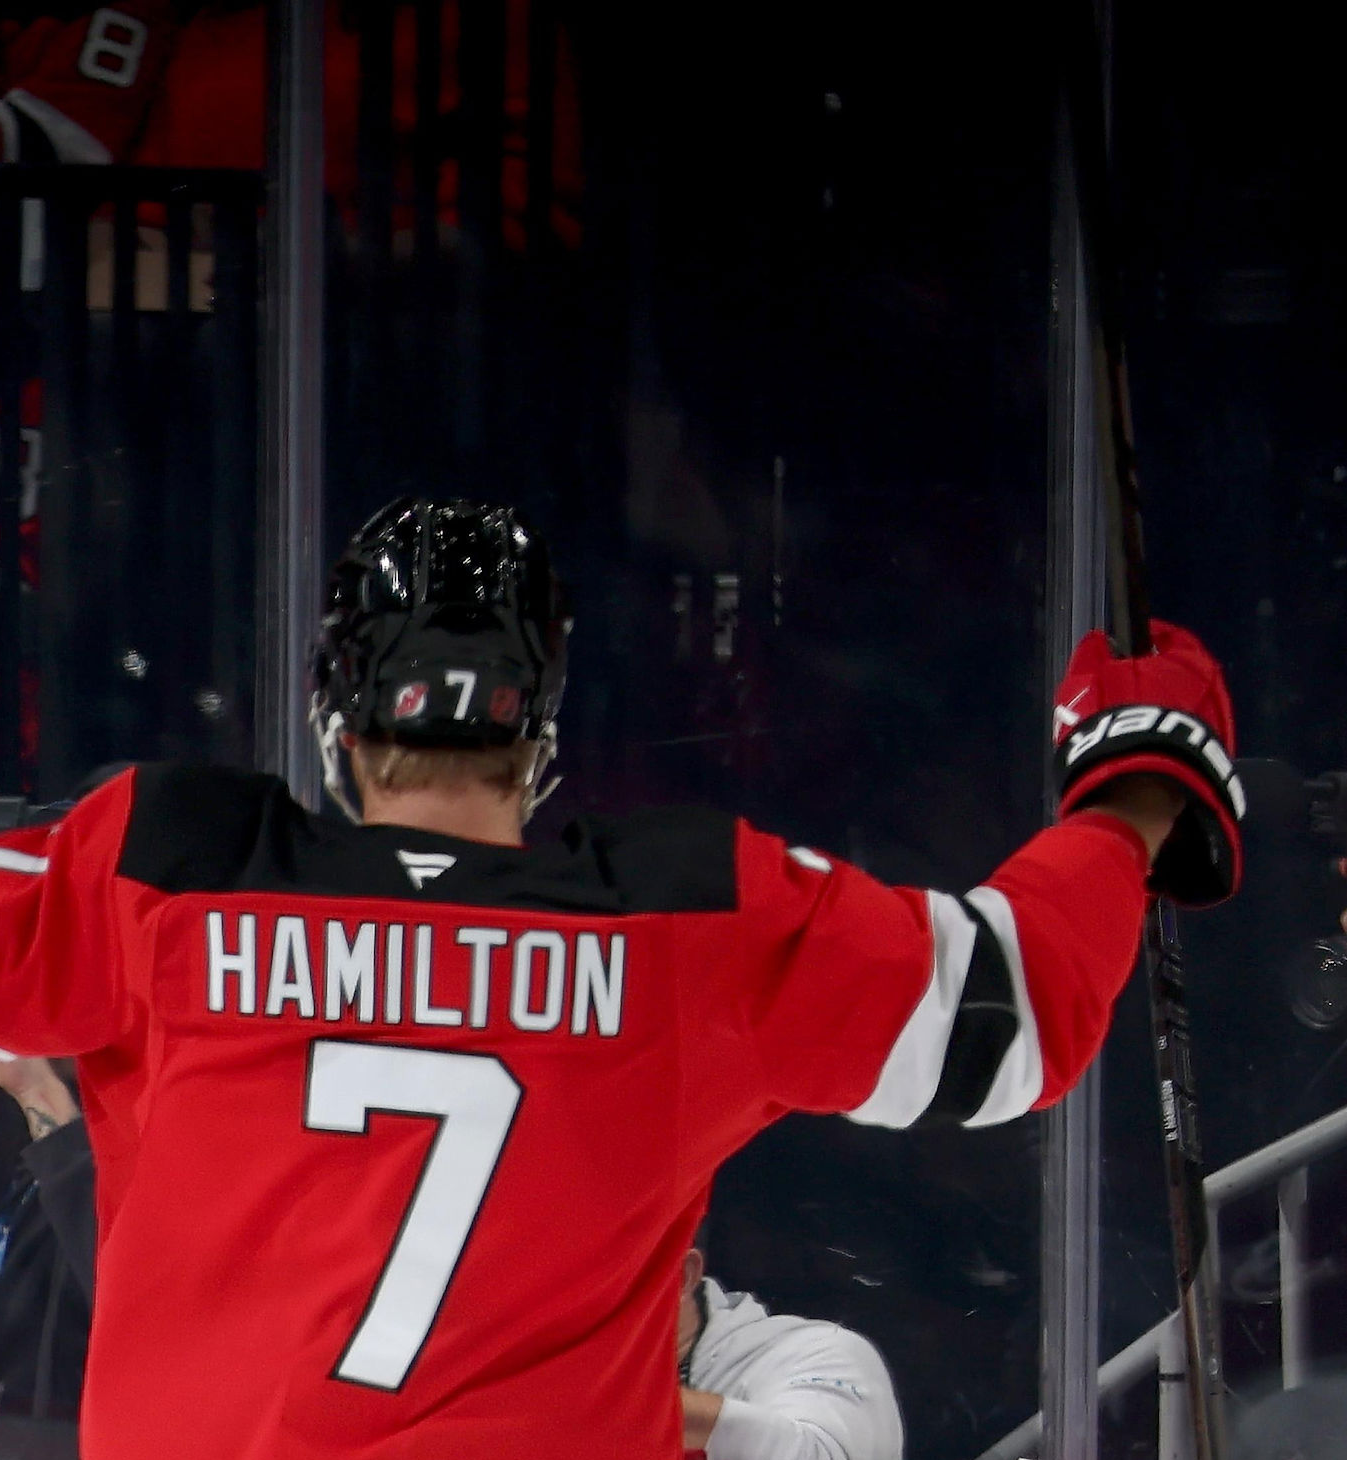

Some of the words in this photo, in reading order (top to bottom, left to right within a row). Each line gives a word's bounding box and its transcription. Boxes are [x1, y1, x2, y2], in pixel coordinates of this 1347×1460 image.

[79, 7, 148, 88] 8
[445, 669, 477, 721] 7
[1066, 705, 1247, 822] UER
[206, 910, 626, 1038] HAMILTON
[302, 1038, 524, 1393] 7
